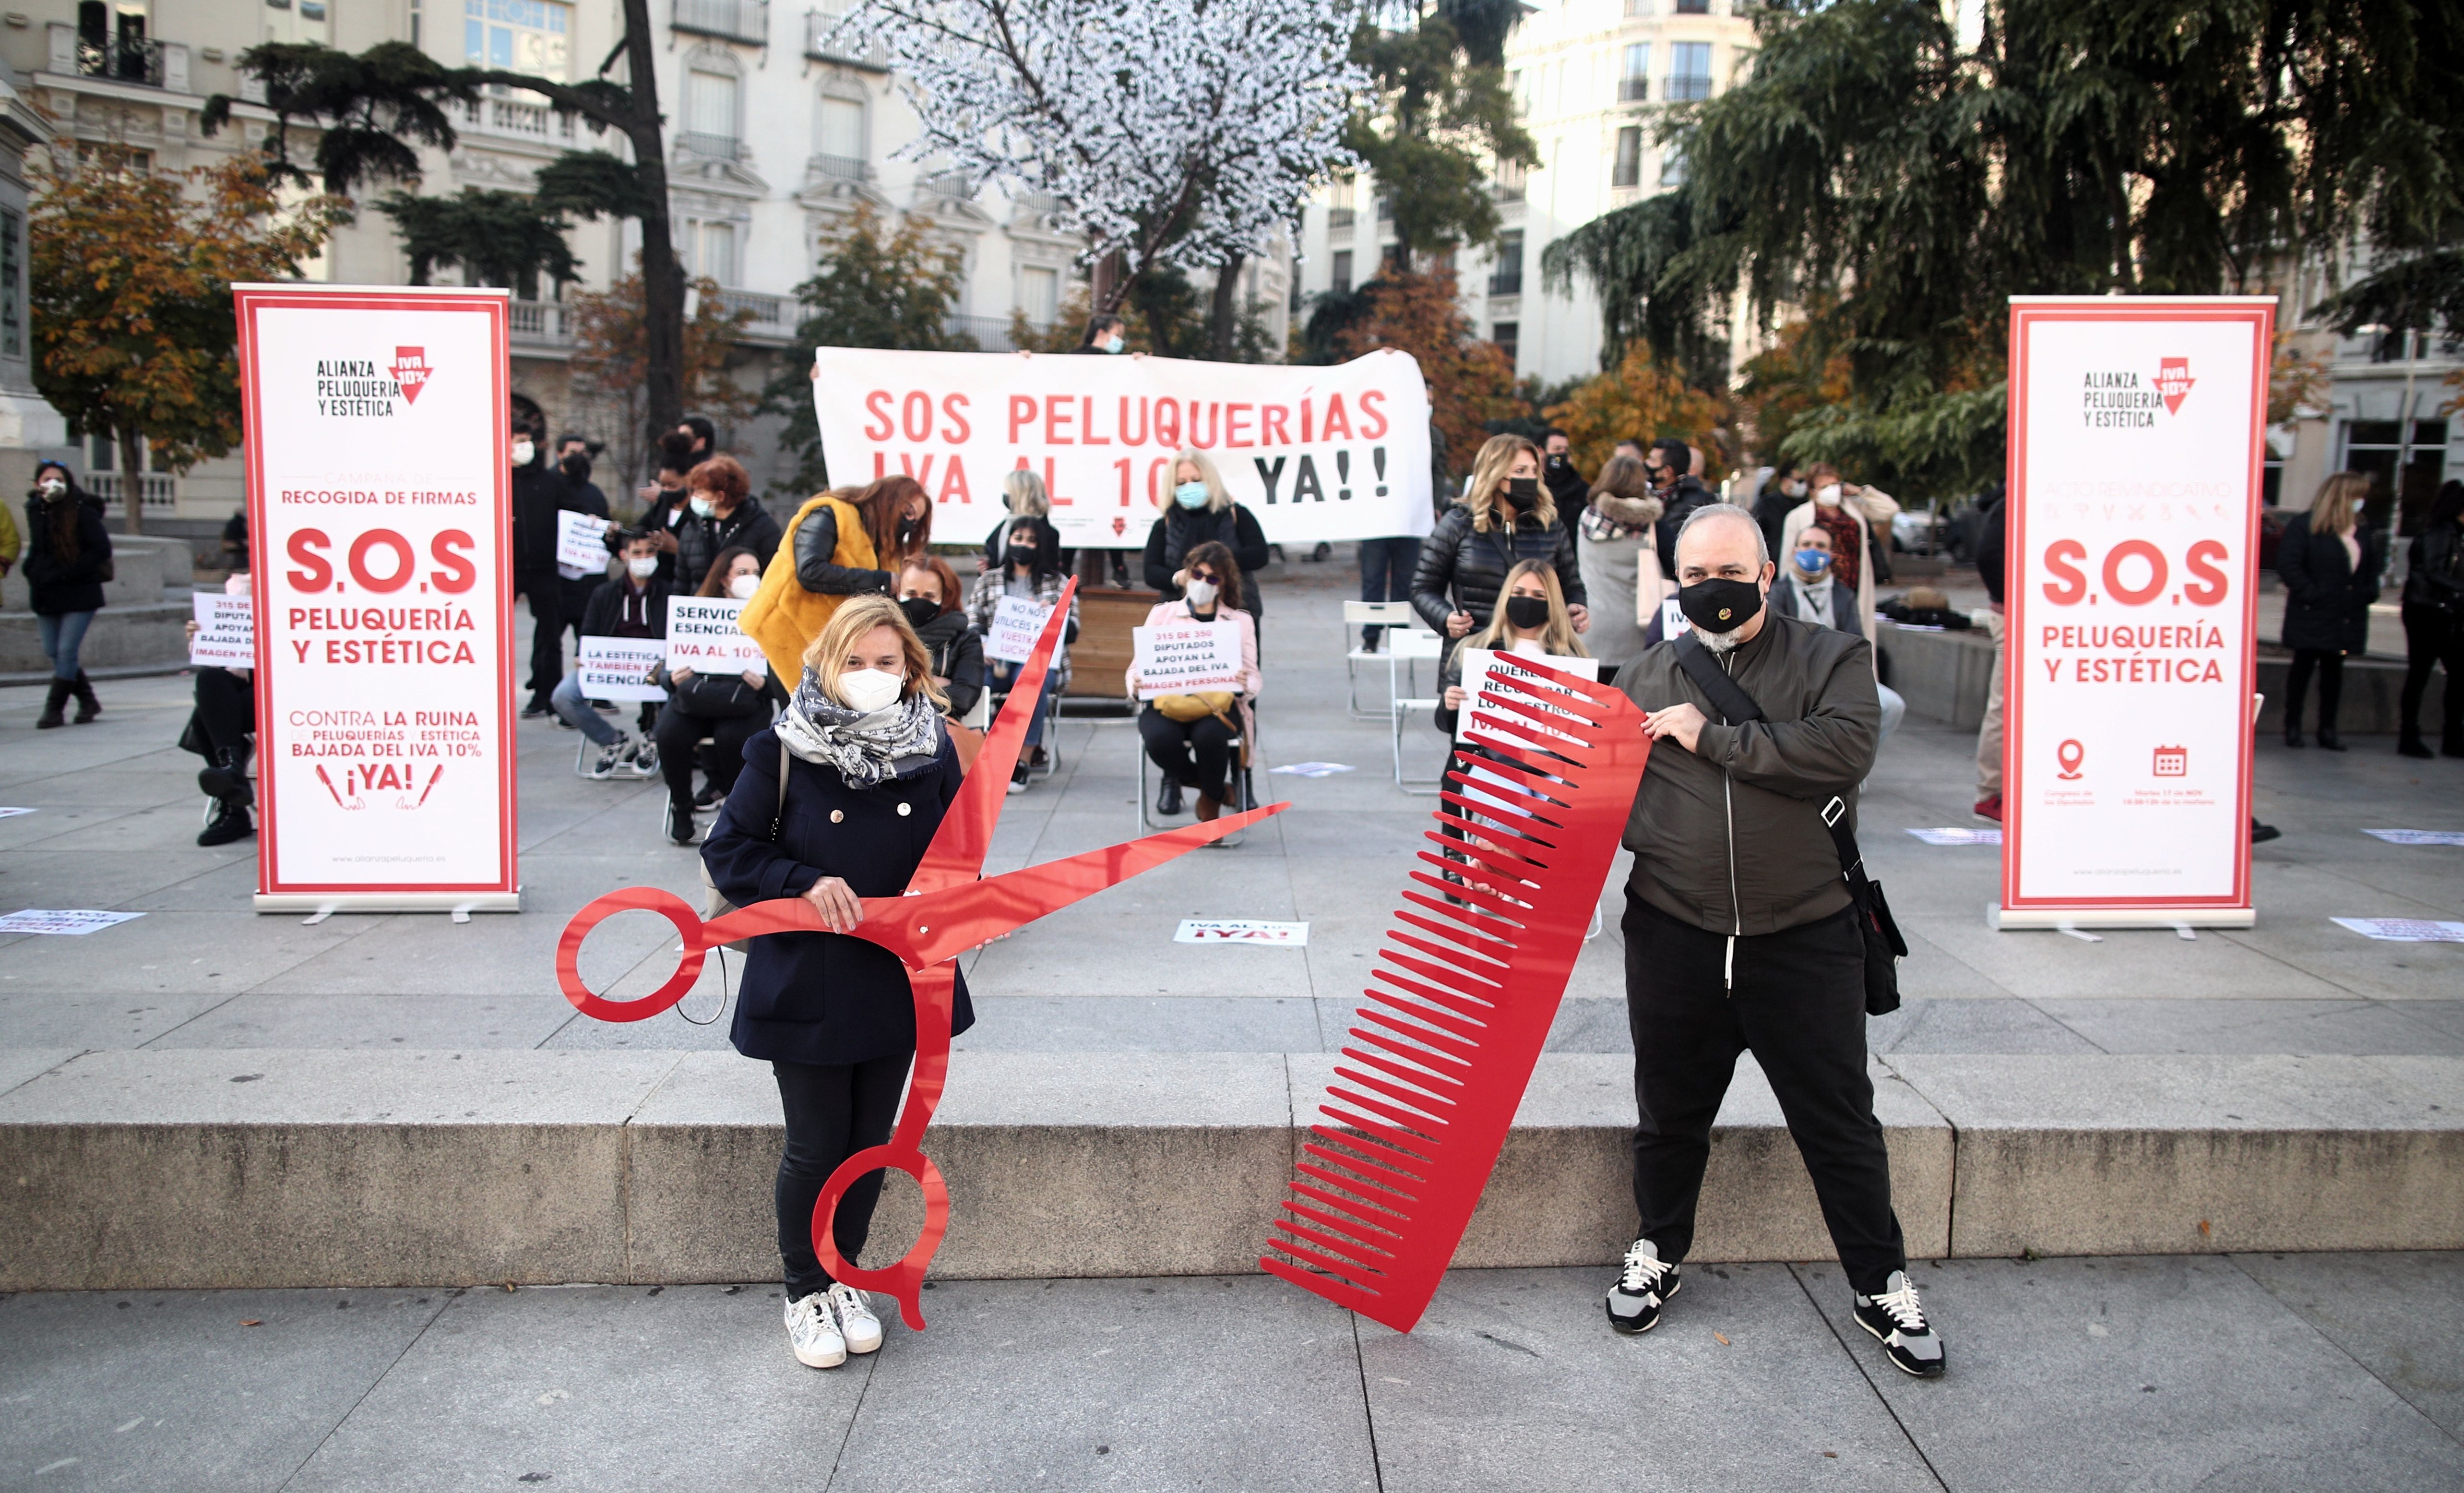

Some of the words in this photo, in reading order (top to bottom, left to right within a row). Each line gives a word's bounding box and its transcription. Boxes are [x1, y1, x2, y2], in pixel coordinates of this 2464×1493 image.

[317, 360, 375, 377] ALIANZA
[398, 356, 422, 369] IVA
[397, 370, 427, 385] 10%
[2084, 372, 2138, 389] ALIANZA
[2162, 366, 2186, 381] IVA
[318, 381, 401, 398] PELUQUERIA
[2161, 382, 2191, 396] 10%
[319, 400, 326, 416] Y
[331, 397, 393, 417] ESTÉTICA
[2084, 392, 2164, 409] PELUQUERIA
[864, 390, 972, 445] SOS
[1008, 385, 1388, 451] PELUQUERÍAS
[2084, 411, 2091, 427] Y
[2096, 408, 2155, 427] ESTÉTICA
[415, 473, 433, 485] DE
[1015, 455, 1073, 506] L
[1253, 445, 1388, 505] YA!!
[282, 490, 378, 504] RECOGIDA
[385, 491, 405, 504] DE
[412, 491, 477, 505] FIRMAS
[287, 528, 476, 595] S.O.S
[2042, 538, 2229, 607] S.O.S
[289, 601, 475, 630] PELUQUERÍA
[676, 606, 742, 620] SERVIC
[1011, 602, 1026, 614] NO
[1027, 608, 1047, 619] NOS
[1671, 611, 1689, 623] IV
[201, 635, 241, 644] BAJADA
[1177, 631, 1190, 639] DE
[1194, 629, 1213, 637] 350
[2043, 619, 2225, 648] PELUQUERÍA
[292, 640, 311, 663] Y
[326, 633, 475, 664] ESTÉTICA
[674, 644, 700, 655] IVA
[706, 644, 726, 657] AL
[733, 647, 766, 659] 10%
[1154, 640, 1215, 651] DIPUTADOS
[196, 649, 237, 658] IMAGEN
[588, 650, 602, 658] LA
[1155, 653, 1199, 663] APOYAN
[1202, 652, 1215, 660] LA
[646, 663, 654, 672] E
[1143, 667, 1185, 676] BAJADA
[1189, 665, 1208, 673] DEL
[1211, 662, 1229, 670] IVA
[2044, 659, 2062, 682] Y
[2076, 651, 2223, 682] ESTÉTICA
[587, 673, 649, 685] ESENCIA
[1478, 699, 1496, 709] LO
[289, 710, 376, 727] CONTRA
[384, 711, 407, 726] LA
[416, 711, 479, 726] RUINA
[313, 728, 405, 741] PELUQUERÍAS
[421, 728, 480, 741] ESTÉTICA
[292, 743, 365, 757] BAJADA
[373, 743, 403, 757] DEL
[410, 744, 439, 757] IVA
[447, 743, 482, 757] 10%
[347, 764, 413, 796] ¡YA!
